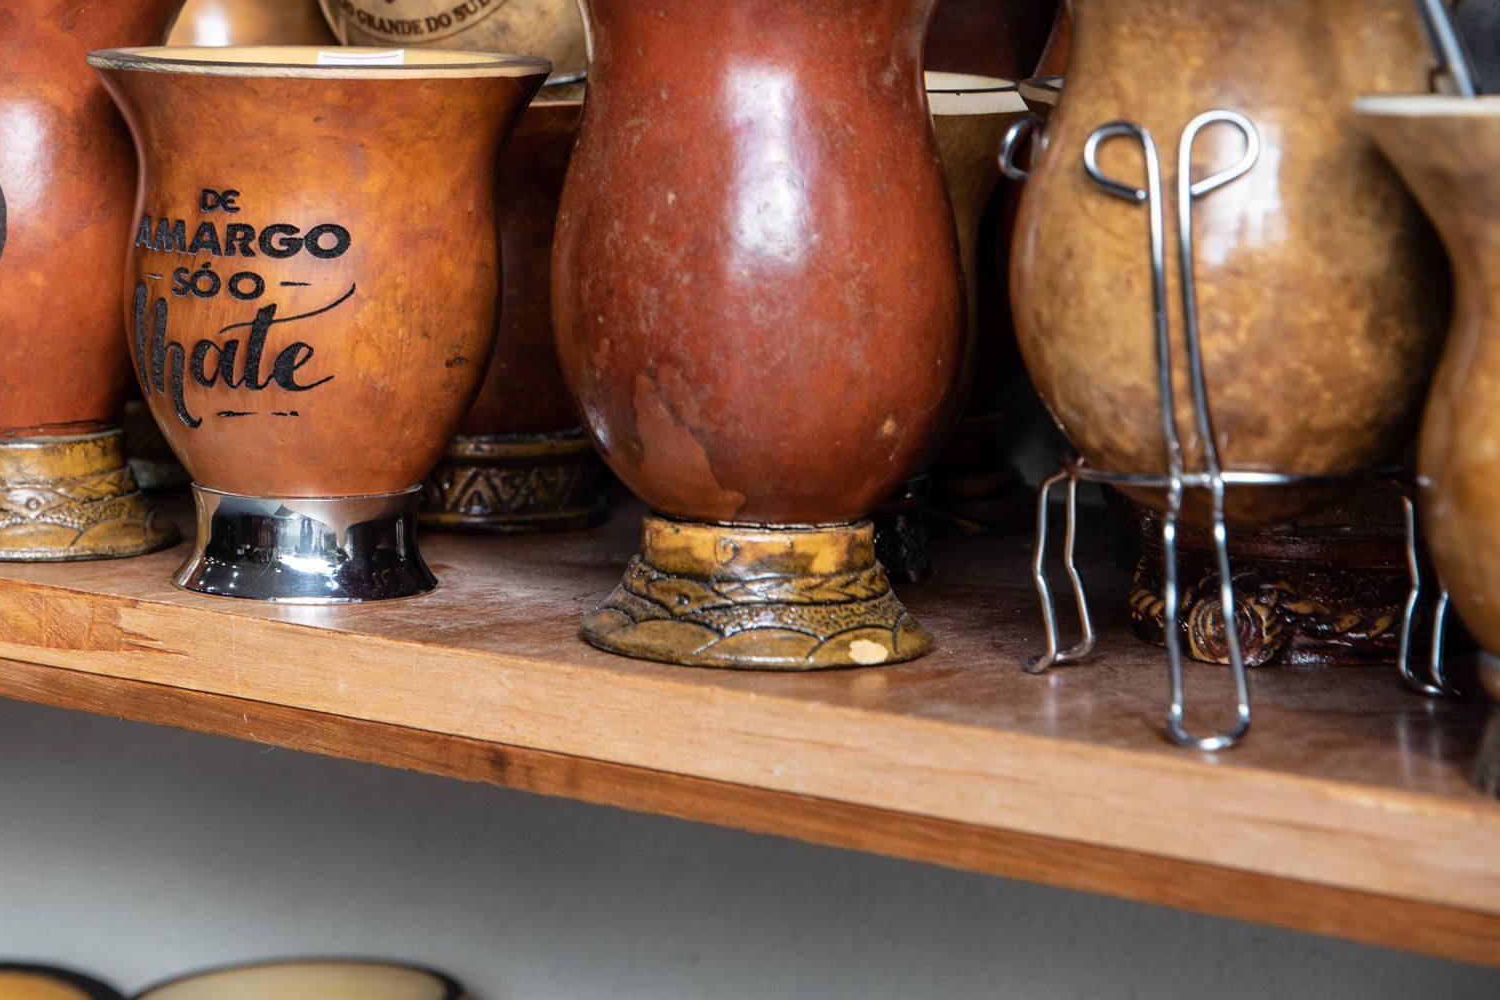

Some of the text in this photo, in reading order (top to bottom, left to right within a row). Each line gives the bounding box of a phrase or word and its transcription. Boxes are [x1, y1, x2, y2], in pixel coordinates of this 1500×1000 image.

[357, 9, 424, 35] GRANDE
[425, 13, 452, 33] DO
[201, 188, 240, 213] DE
[135, 214, 351, 259] AMARGO
[171, 262, 266, 300] SÓ O
